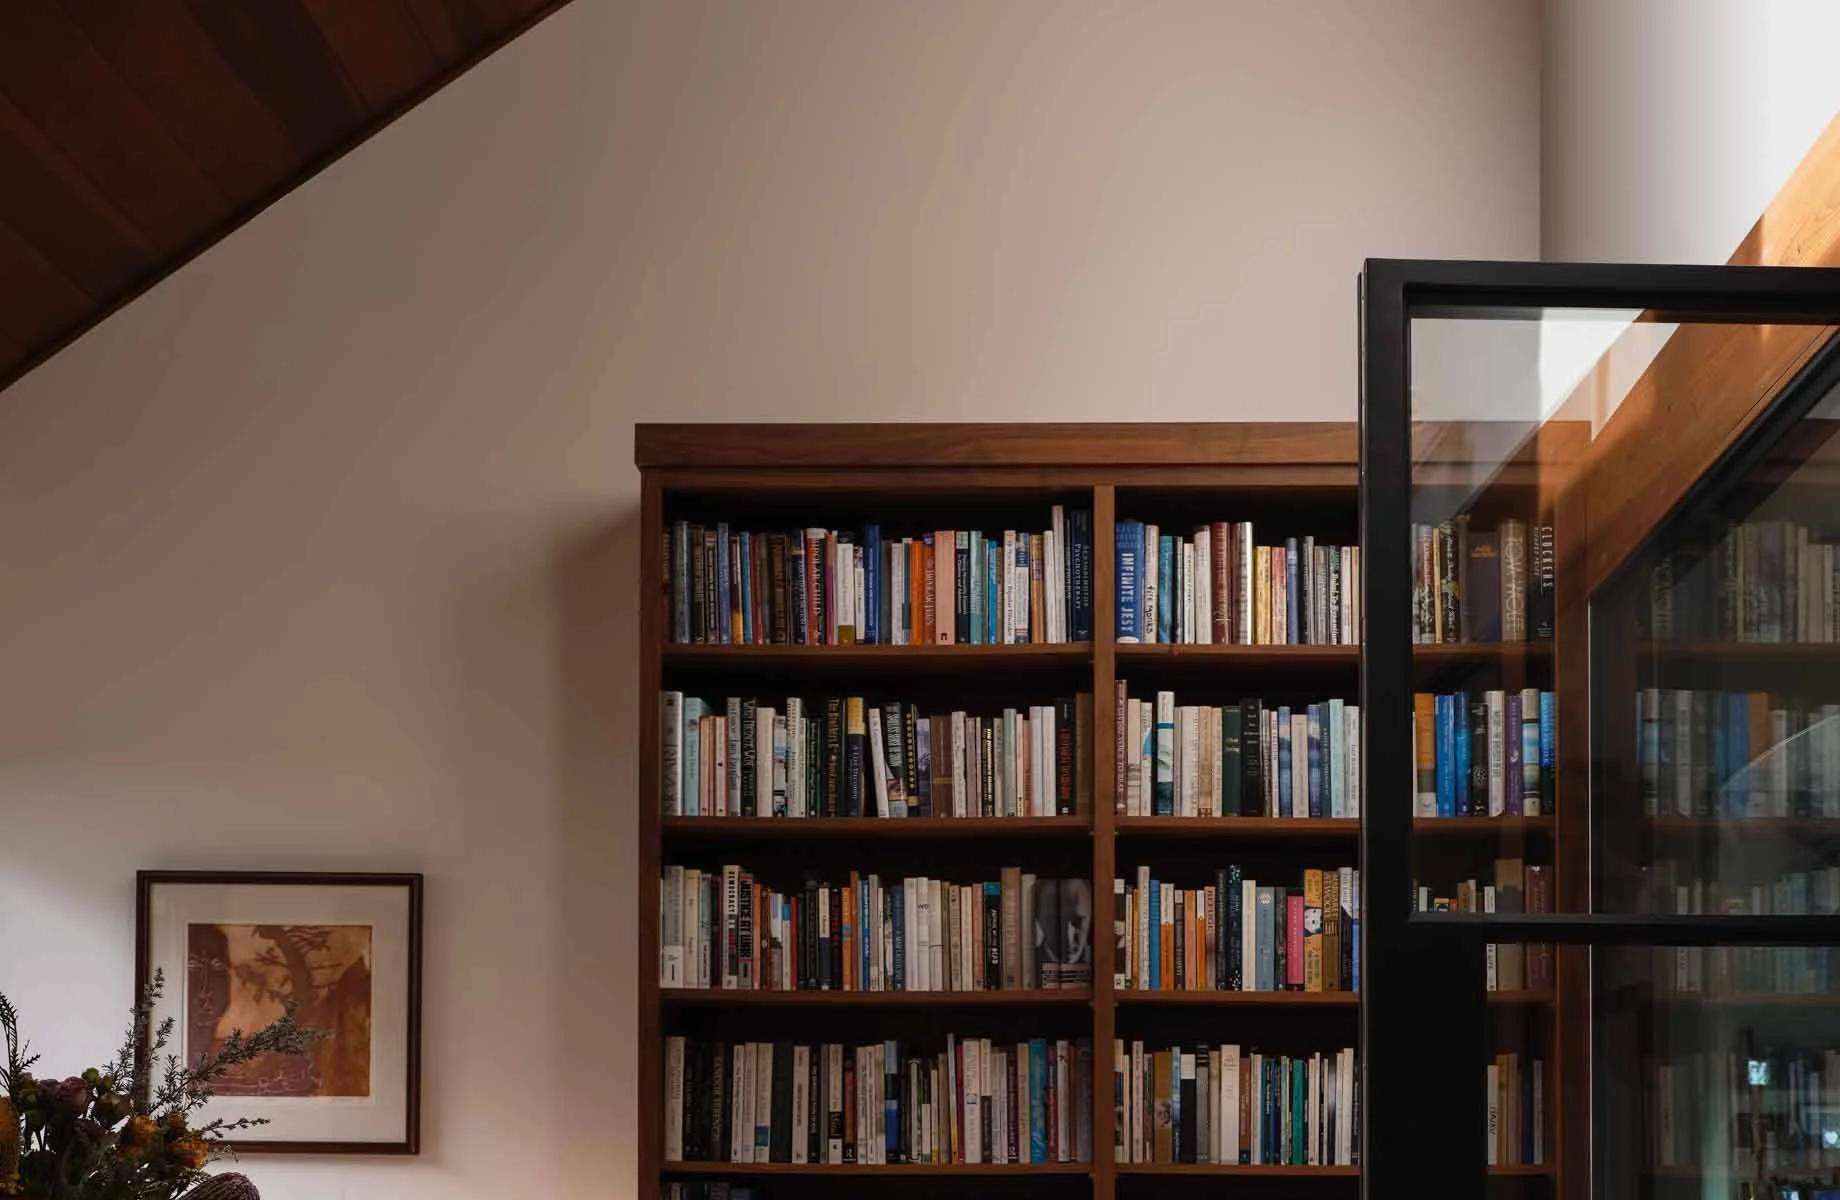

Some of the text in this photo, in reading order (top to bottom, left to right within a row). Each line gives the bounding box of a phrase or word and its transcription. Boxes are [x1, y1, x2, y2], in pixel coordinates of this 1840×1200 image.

[1074, 543, 1082, 609] PSYCHOTHERAPY
[1504, 536, 1524, 633] TOM WOLFE
[1542, 526, 1553, 589] CLOCKERS
[1120, 552, 1135, 633] INFINITE JEST
[728, 871, 736, 915] DEMOCRACY
[740, 880, 752, 957] JUSTICE AT WAR
[1323, 871, 1331, 918] ATWOOD
